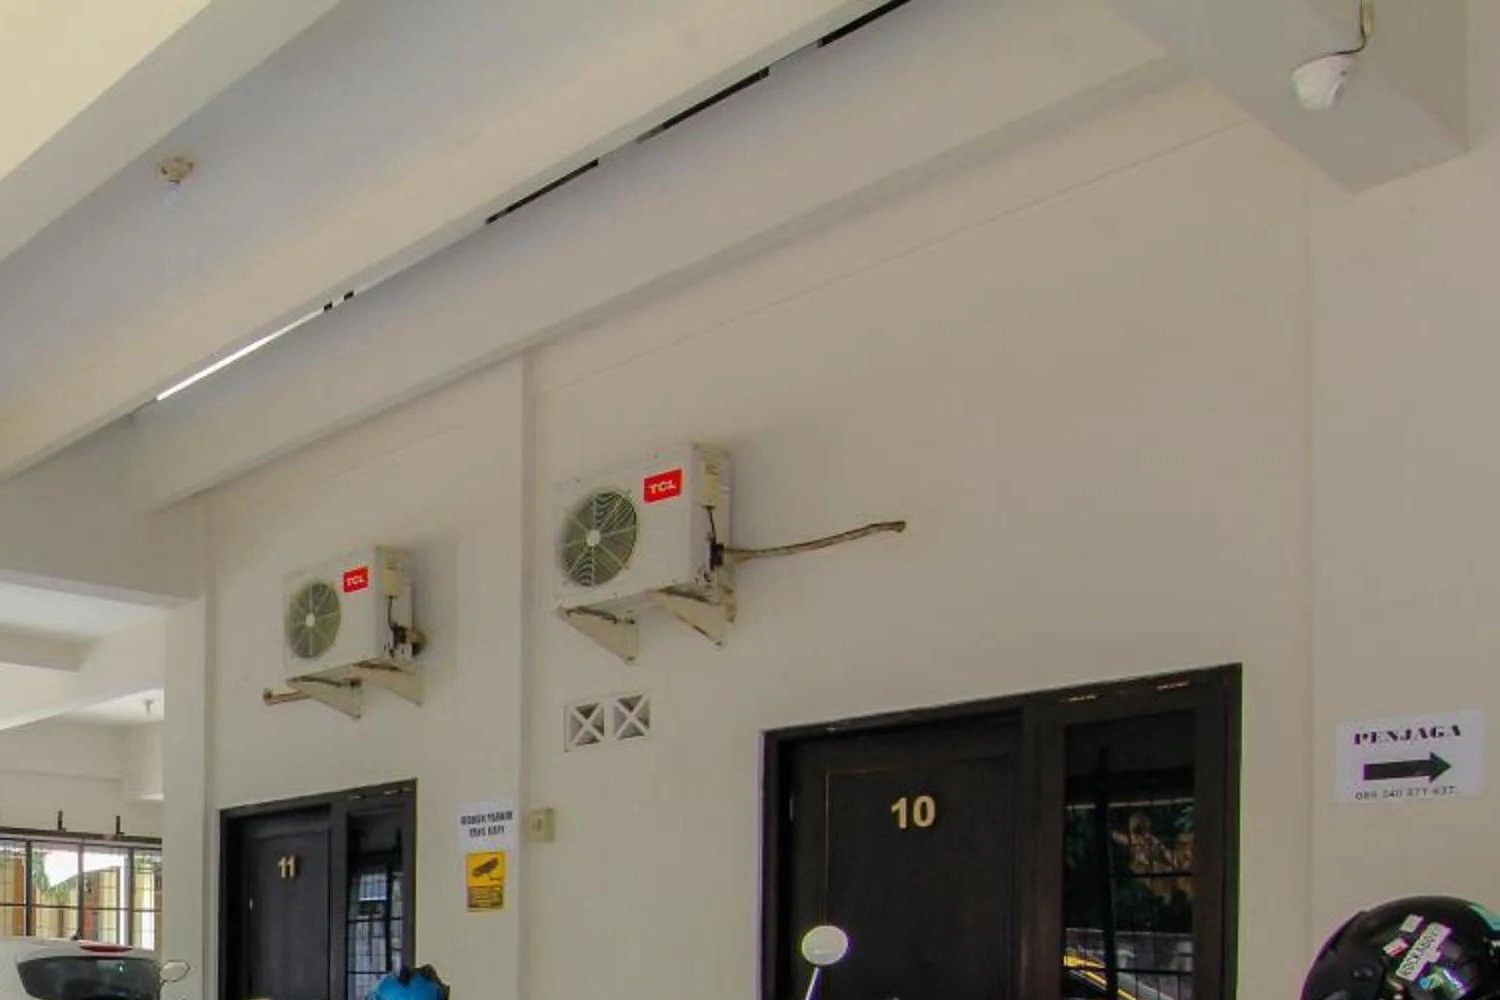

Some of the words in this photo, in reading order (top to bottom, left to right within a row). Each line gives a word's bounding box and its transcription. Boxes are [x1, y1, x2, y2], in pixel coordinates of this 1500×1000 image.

[647, 480, 677, 495] TCL
[345, 575, 366, 587] TCL
[1354, 724, 1462, 745] PENJAGA
[890, 795, 936, 829] 10
[277, 856, 296, 879] 11
